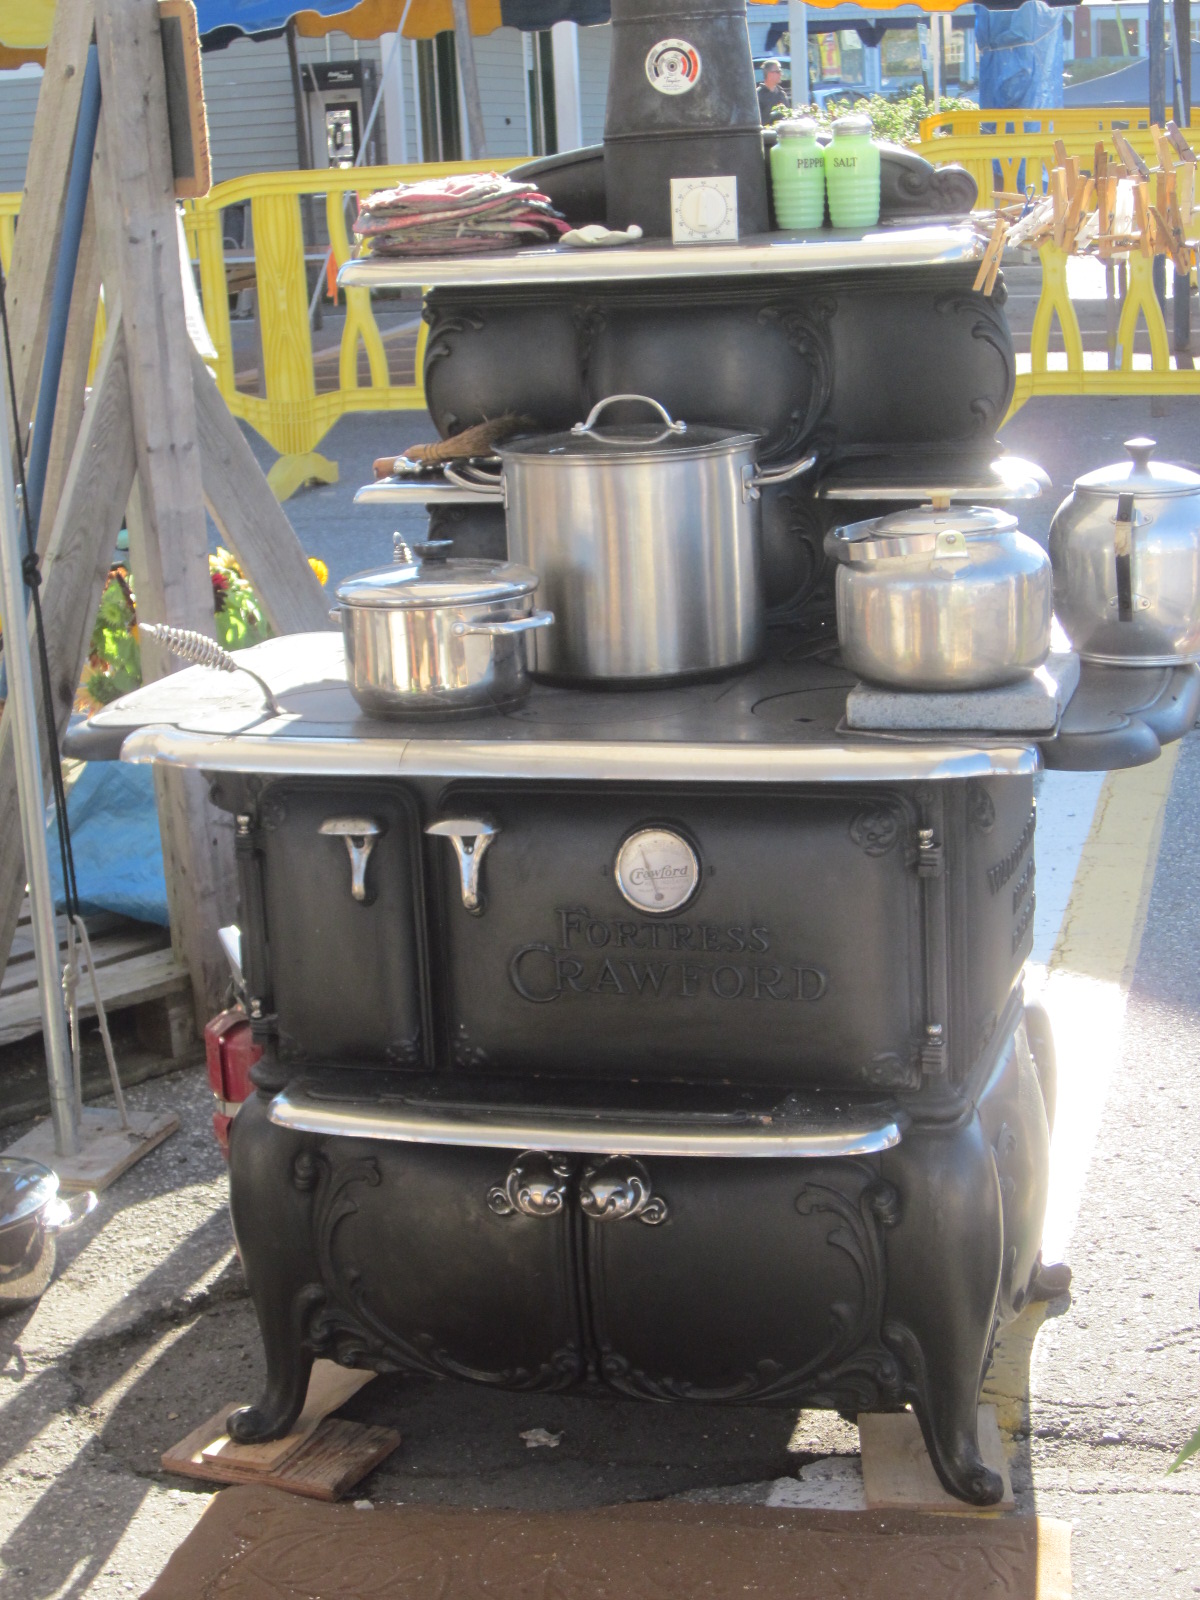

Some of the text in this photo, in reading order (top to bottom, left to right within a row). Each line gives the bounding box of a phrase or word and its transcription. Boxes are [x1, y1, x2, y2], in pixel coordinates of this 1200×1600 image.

[797, 158, 825, 168] PEPPE
[833, 157, 857, 168] SALT
[629, 865, 688, 886] Crawford
[557, 907, 769, 951] FORTRESS
[509, 944, 828, 1002] CRAWFORD
